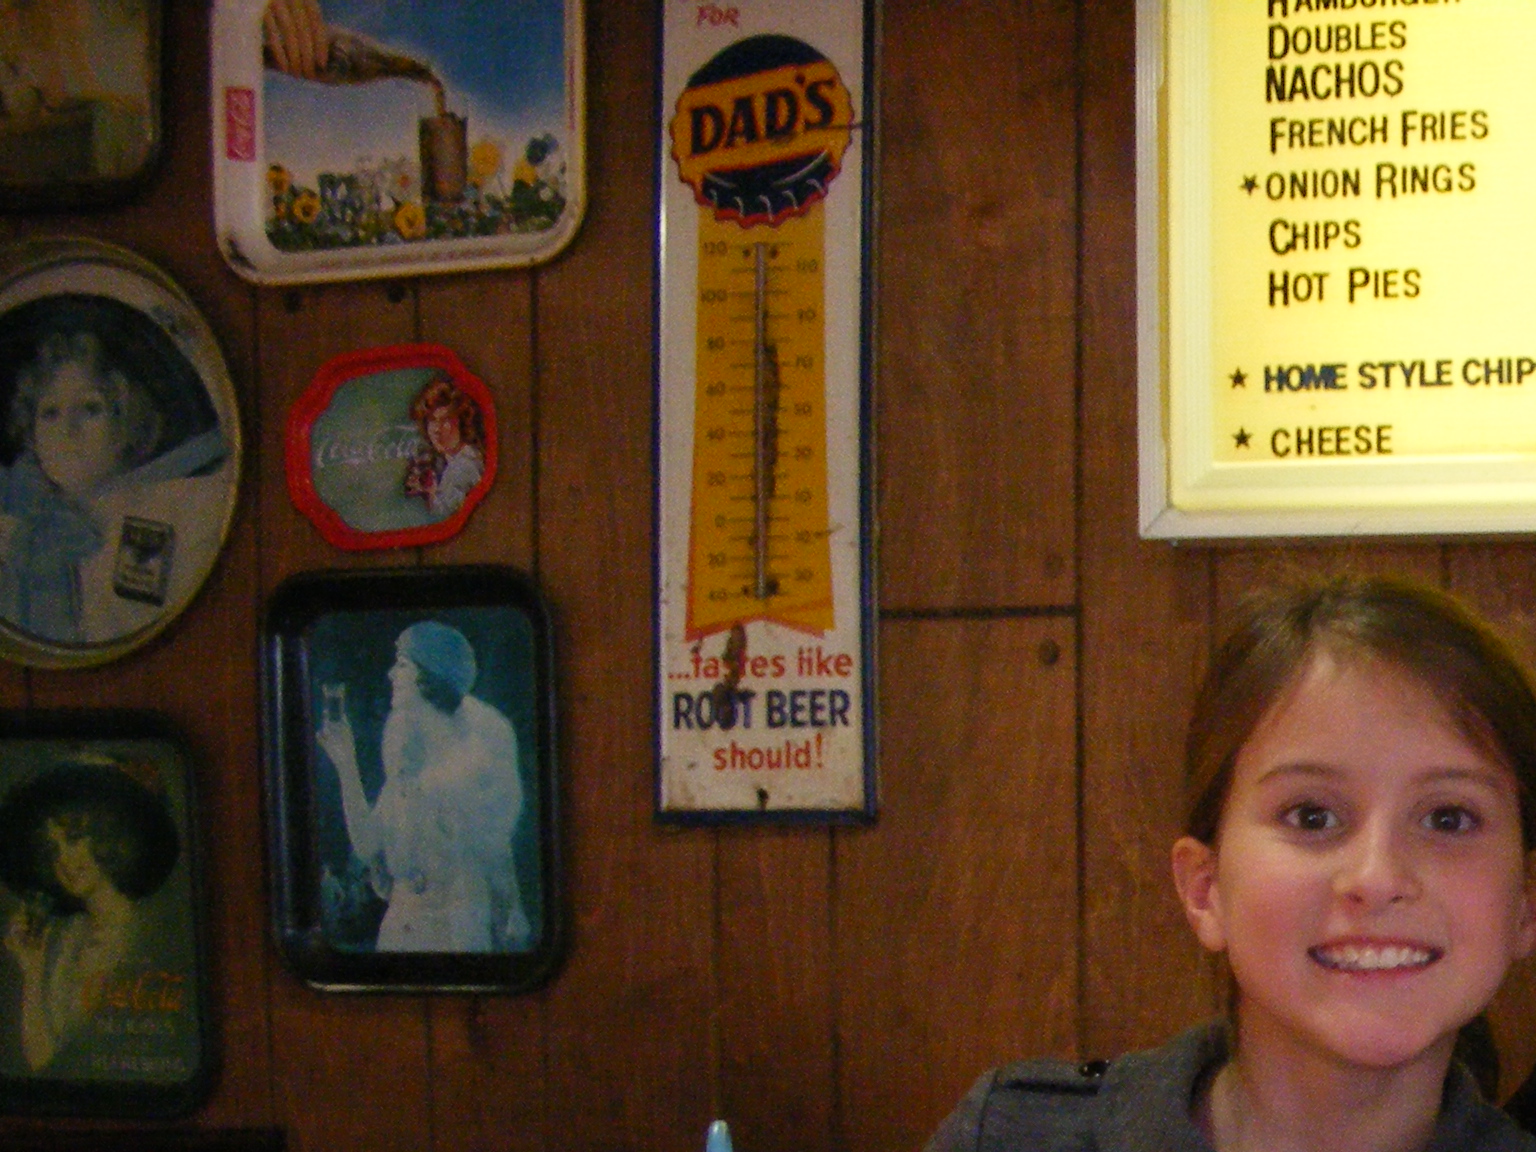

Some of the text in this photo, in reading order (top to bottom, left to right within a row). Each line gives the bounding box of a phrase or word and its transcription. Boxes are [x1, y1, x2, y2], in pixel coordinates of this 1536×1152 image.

[1267, 20, 1407, 60] DOUBLES
[1265, 61, 1404, 104] NACHOS
[690, 74, 836, 156] DAD'S
[1269, 109, 1489, 155] FRENCH FRIES
[1265, 162, 1477, 202] ONION RINGS
[1268, 218, 1362, 255] CHIPS
[1268, 266, 1422, 308] HOT PIES
[1263, 363, 1348, 393] HOME
[1357, 359, 1454, 391] STYLE
[1270, 425, 1393, 459] CHEESE
[797, 645, 853, 678] like
[673, 687, 851, 731] ROOT BEER
[712, 732, 823, 771] should!
